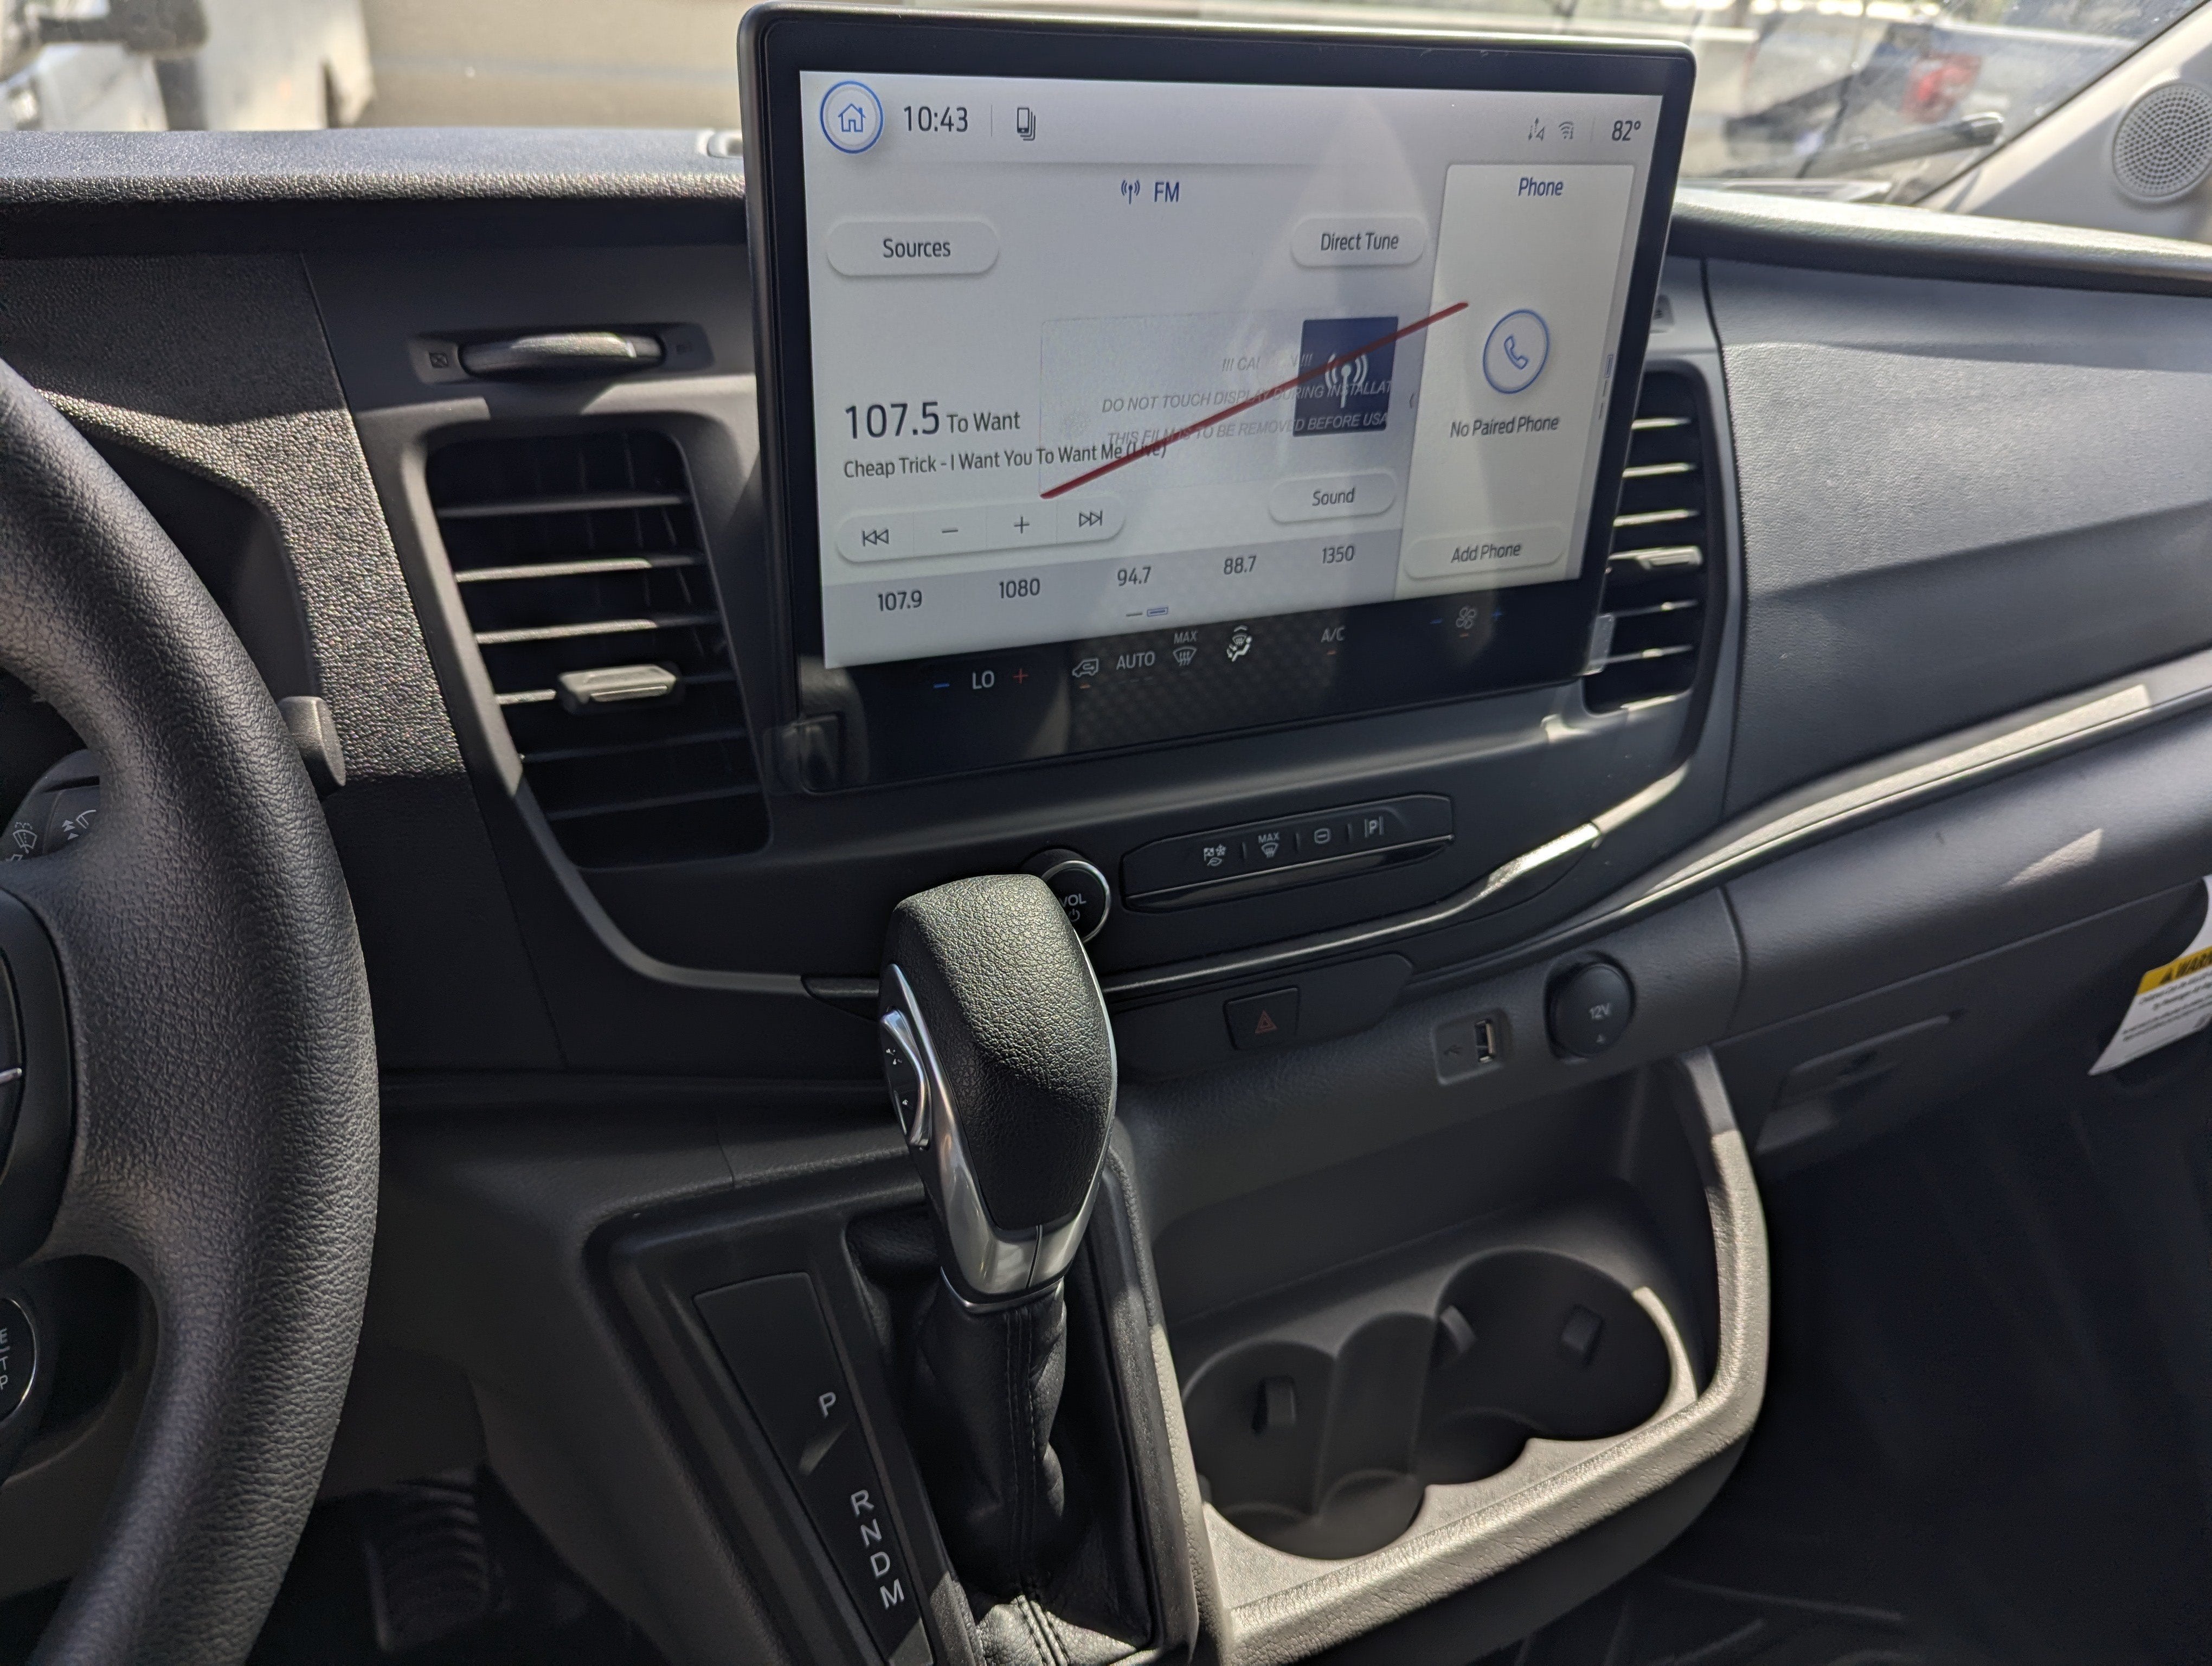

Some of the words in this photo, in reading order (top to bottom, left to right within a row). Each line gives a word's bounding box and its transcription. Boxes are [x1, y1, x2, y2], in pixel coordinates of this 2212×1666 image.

[903, 106, 969, 133] 10:43
[1611, 120, 1642, 142] 82°
[1154, 181, 1180, 203] FM
[1517, 177, 1563, 196] Phone
[883, 238, 951, 259] Sources
[1320, 232, 1361, 252] Direct
[1365, 232, 1399, 251] Tune
[1102, 398, 1124, 413] DO
[1127, 396, 1159, 411] NOT
[1163, 392, 1211, 409] TOUCH
[845, 401, 940, 440] 107.5
[947, 414, 969, 433] To
[973, 411, 1021, 432] Want
[1108, 431, 1139, 446] THIS
[1216, 423, 1236, 438] BE
[1238, 419, 1304, 437] REMOVED
[1307, 413, 1361, 431] BEFORE
[1450, 421, 1469, 439] No
[1473, 418, 1514, 436] Paired
[1517, 415, 1559, 433] Phone
[844, 459, 895, 479] Cheap
[899, 455, 937, 475] Trick
[951, 454, 955, 471] I
[959, 451, 1001, 470] Want
[1004, 450, 1032, 467] You
[1036, 448, 1054, 465] To
[1058, 444, 1097, 463] Want
[1101, 443, 1122, 460] Me
[1312, 488, 1355, 507] Sound
[1321, 545, 1355, 565] 1350
[1451, 545, 1477, 563] Add
[1481, 543, 1521, 560] Phone
[1223, 555, 1258, 575] 88.7
[1116, 566, 1152, 586] 94.7
[999, 578, 1040, 599] 1080
[877, 591, 922, 612] 107.9
[1173, 630, 1199, 645] MAX
[1321, 626, 1345, 643] A/C
[1116, 651, 1156, 670] AUTO
[972, 671, 995, 690] LO
[1258, 831, 1280, 844] MAX
[1059, 893, 1086, 907] VOL
[1589, 1003, 1611, 1020] 12V
[819, 1391, 837, 1418] P
[851, 1489, 874, 1516] R
[860, 1518, 883, 1546] N
[870, 1551, 891, 1577] D
[880, 1578, 905, 1610] M
